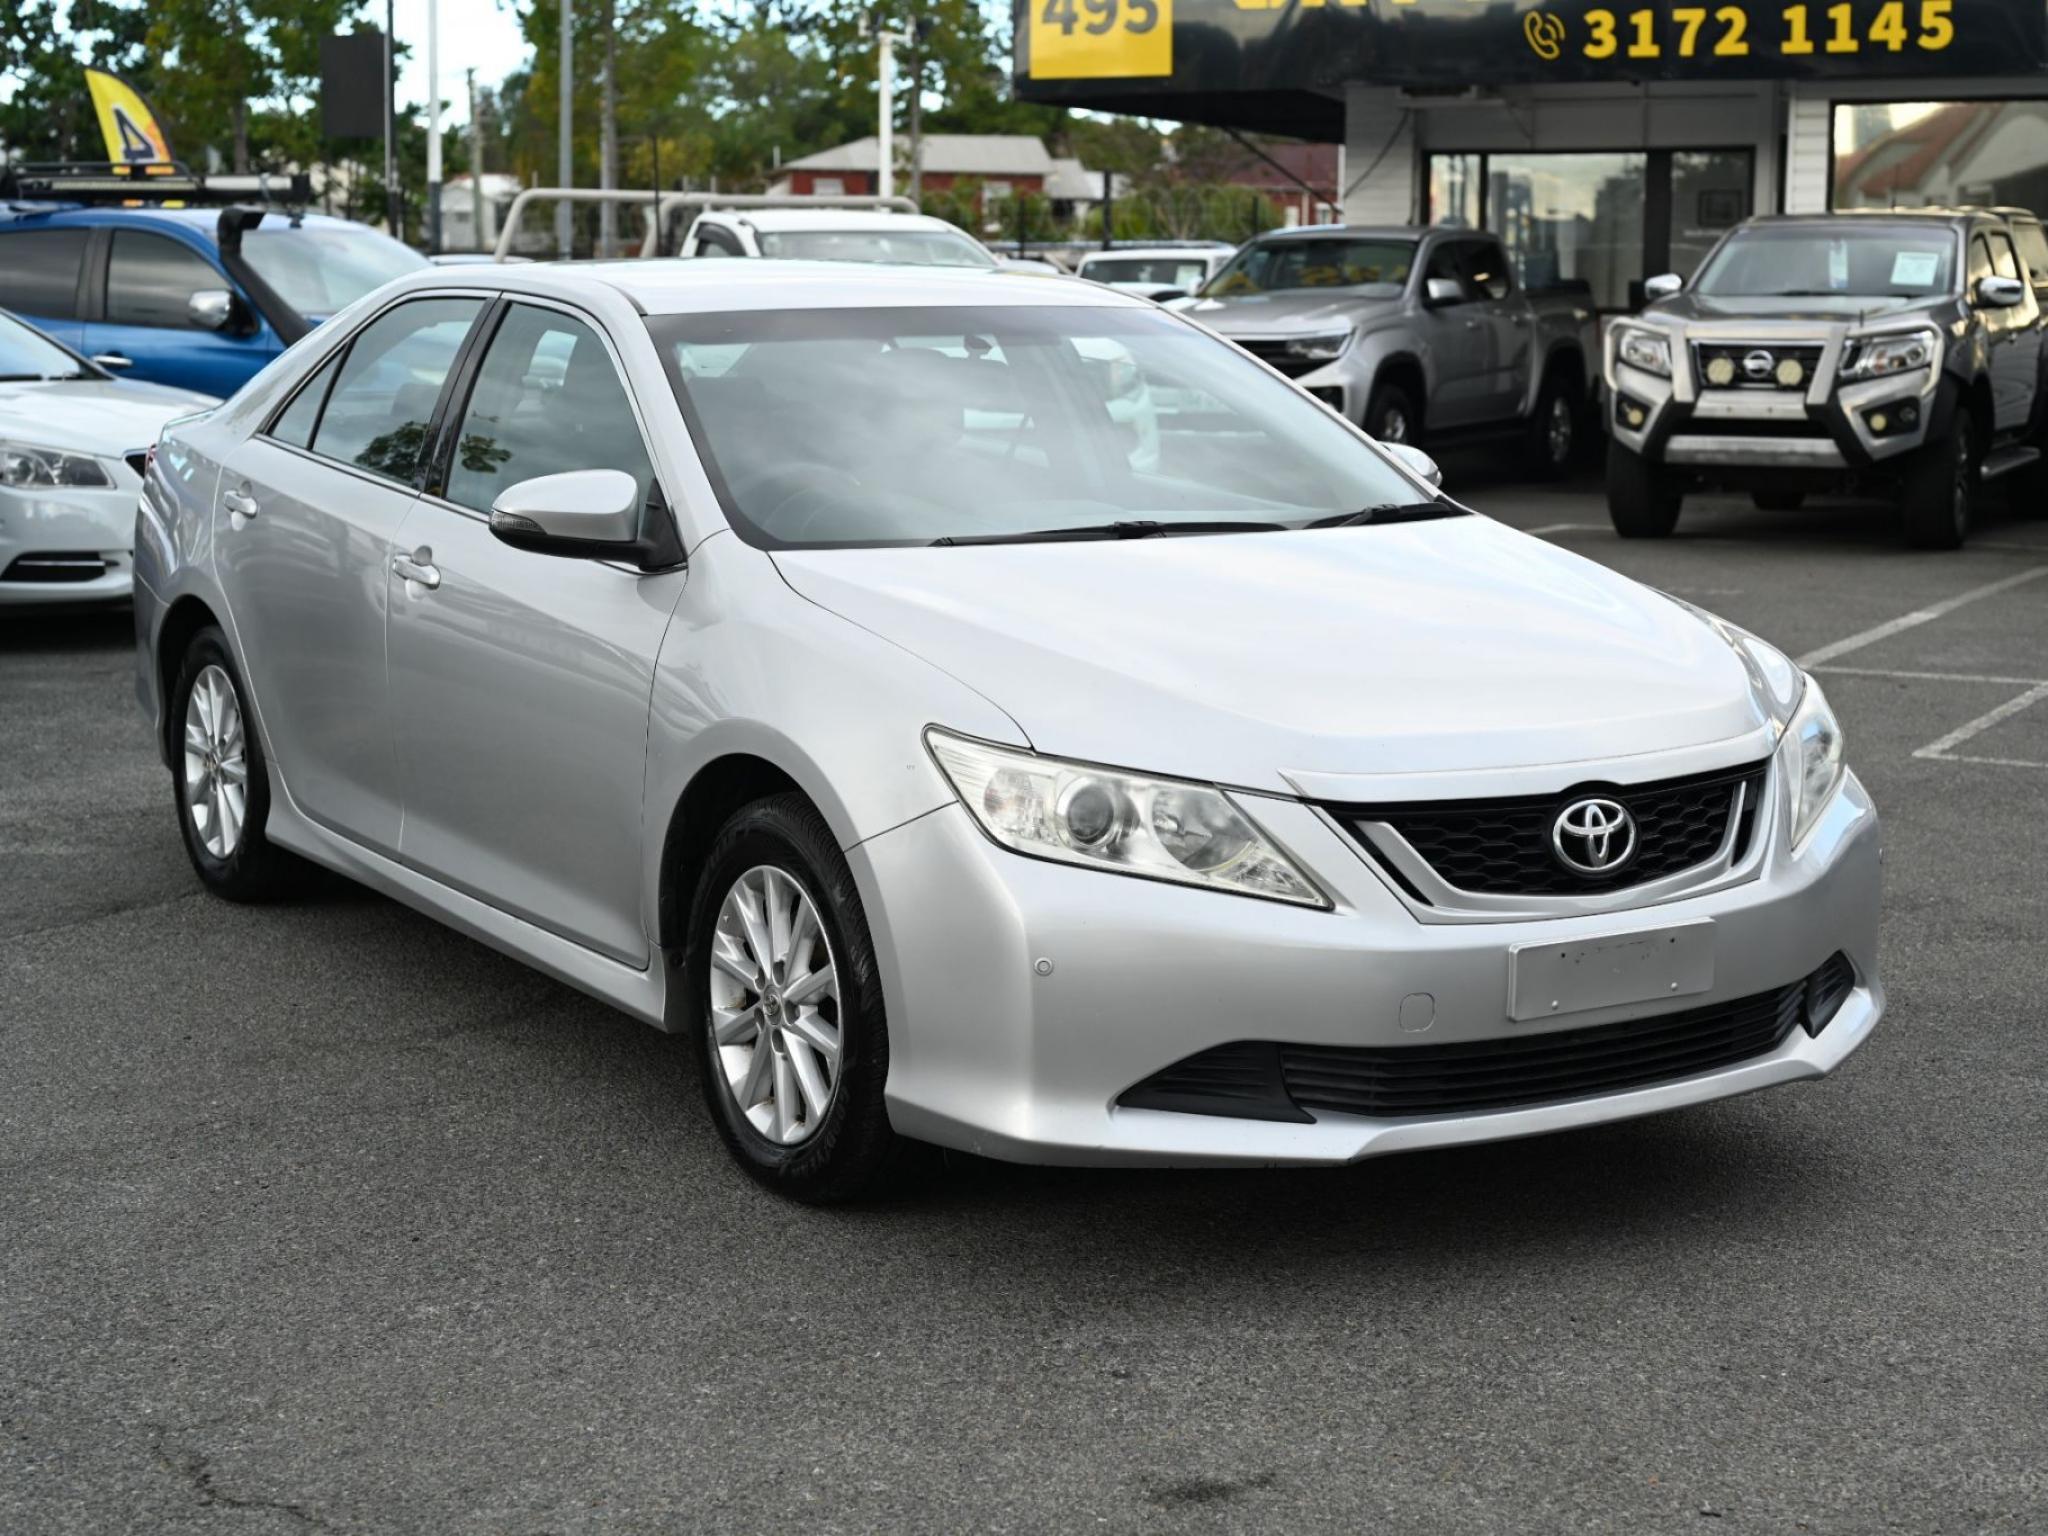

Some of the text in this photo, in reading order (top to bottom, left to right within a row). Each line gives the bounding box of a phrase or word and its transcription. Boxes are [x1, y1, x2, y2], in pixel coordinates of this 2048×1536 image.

[1042, 0, 1159, 36] 495
[1584, 0, 1954, 58] 3172 1145
